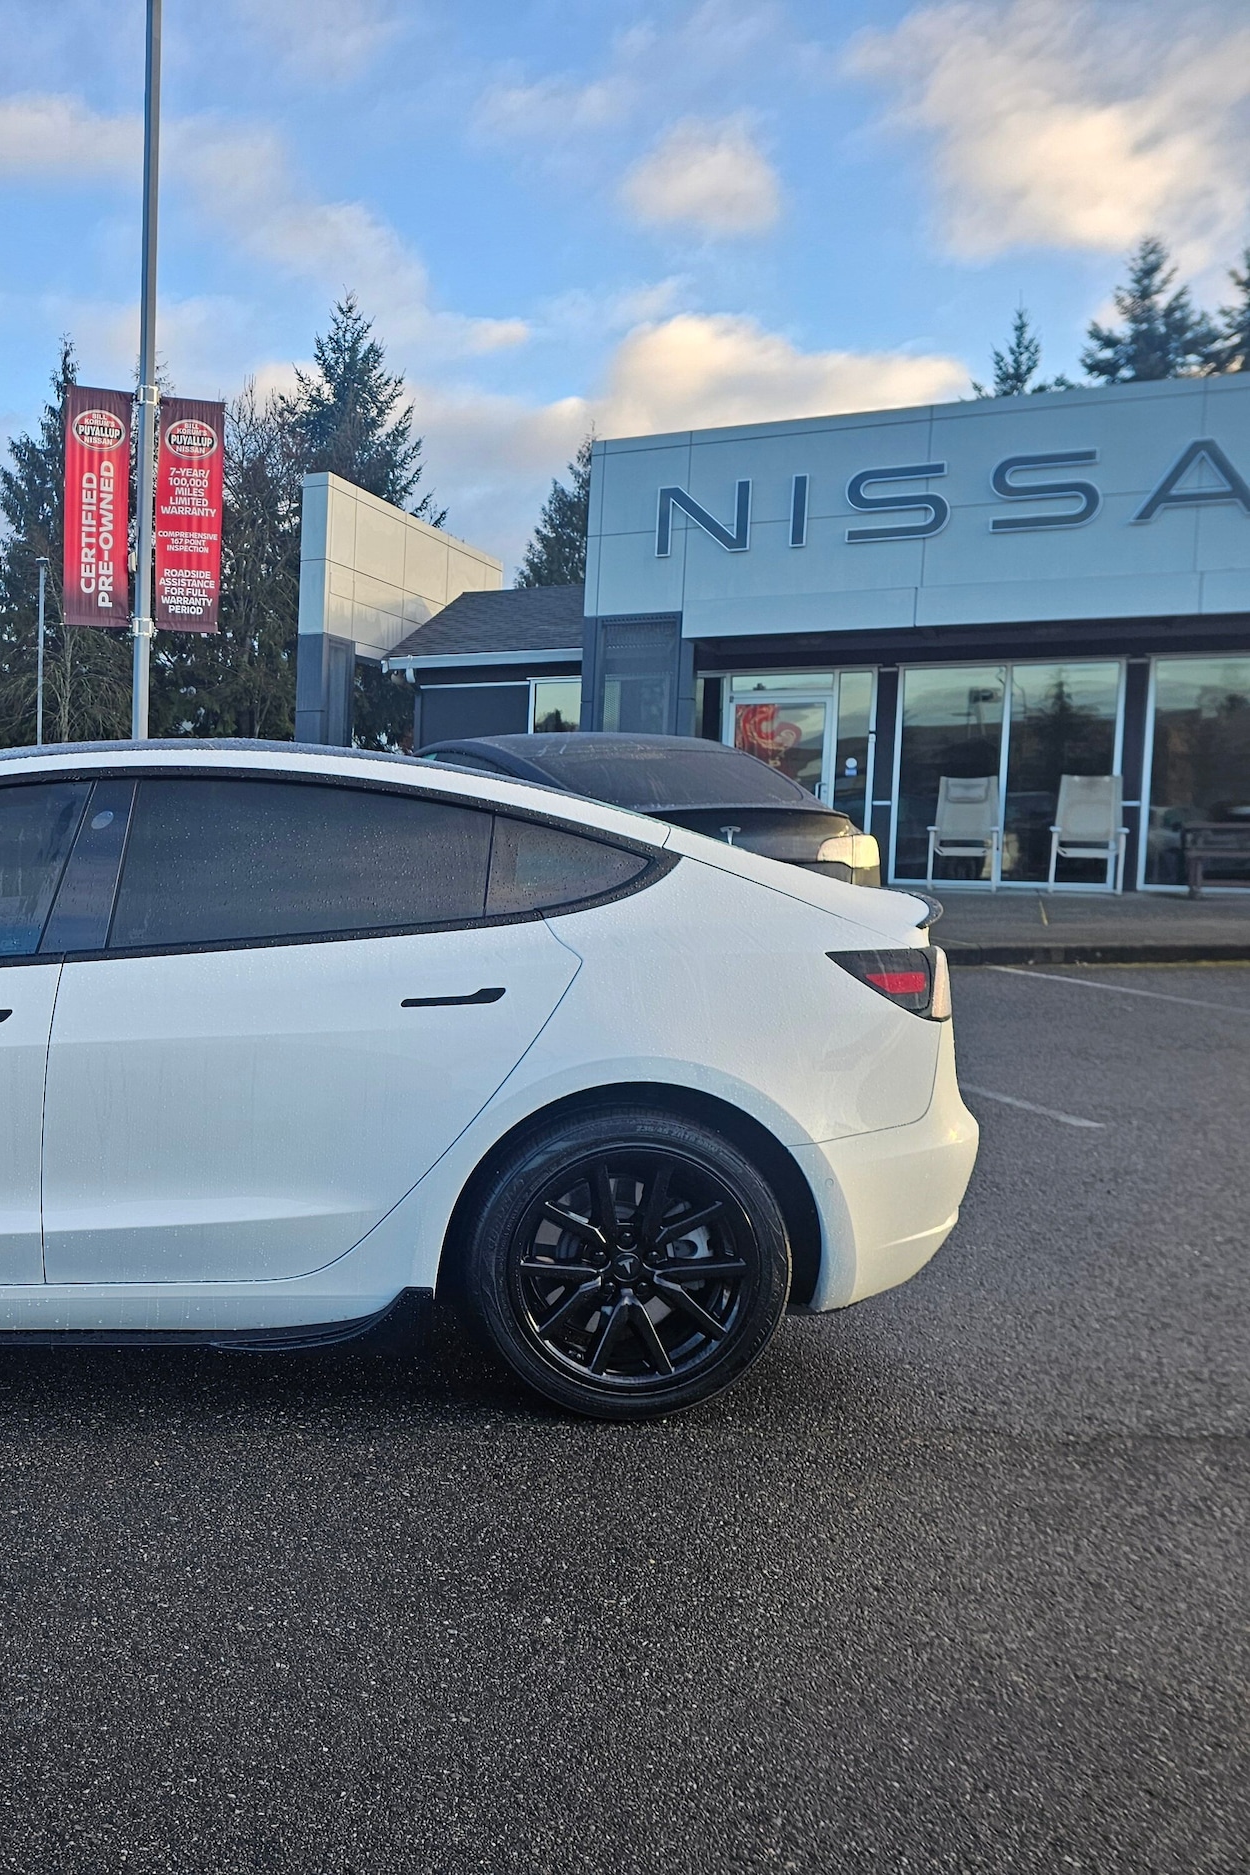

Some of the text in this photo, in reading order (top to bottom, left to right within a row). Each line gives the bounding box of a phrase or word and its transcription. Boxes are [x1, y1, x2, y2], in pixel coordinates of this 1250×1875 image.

[78, 424, 120, 438] PUYALLUP
[84, 436, 113, 446] NISSAN
[171, 434, 212, 447] PUYALLUP
[176, 446, 206, 454] NISSAN
[170, 468, 210, 478] 7-YEAR/
[168, 478, 208, 488] 100,000
[175, 487, 204, 496] MILES
[170, 496, 208, 506] LIMITED
[161, 506, 216, 517] WARRANTY
[80, 472, 97, 594] CERTIFIED
[98, 460, 114, 608] PRE-OWNED
[158, 531, 218, 540] COMPREHENSIVE
[167, 544, 209, 553] INSPECTION
[164, 568, 211, 579] ROADSIDE
[159, 578, 215, 588] ASSISTANCE
[165, 587, 208, 597] FOR FULL
[161, 596, 212, 606] WARRANTY
[169, 605, 203, 615] PERIOD
